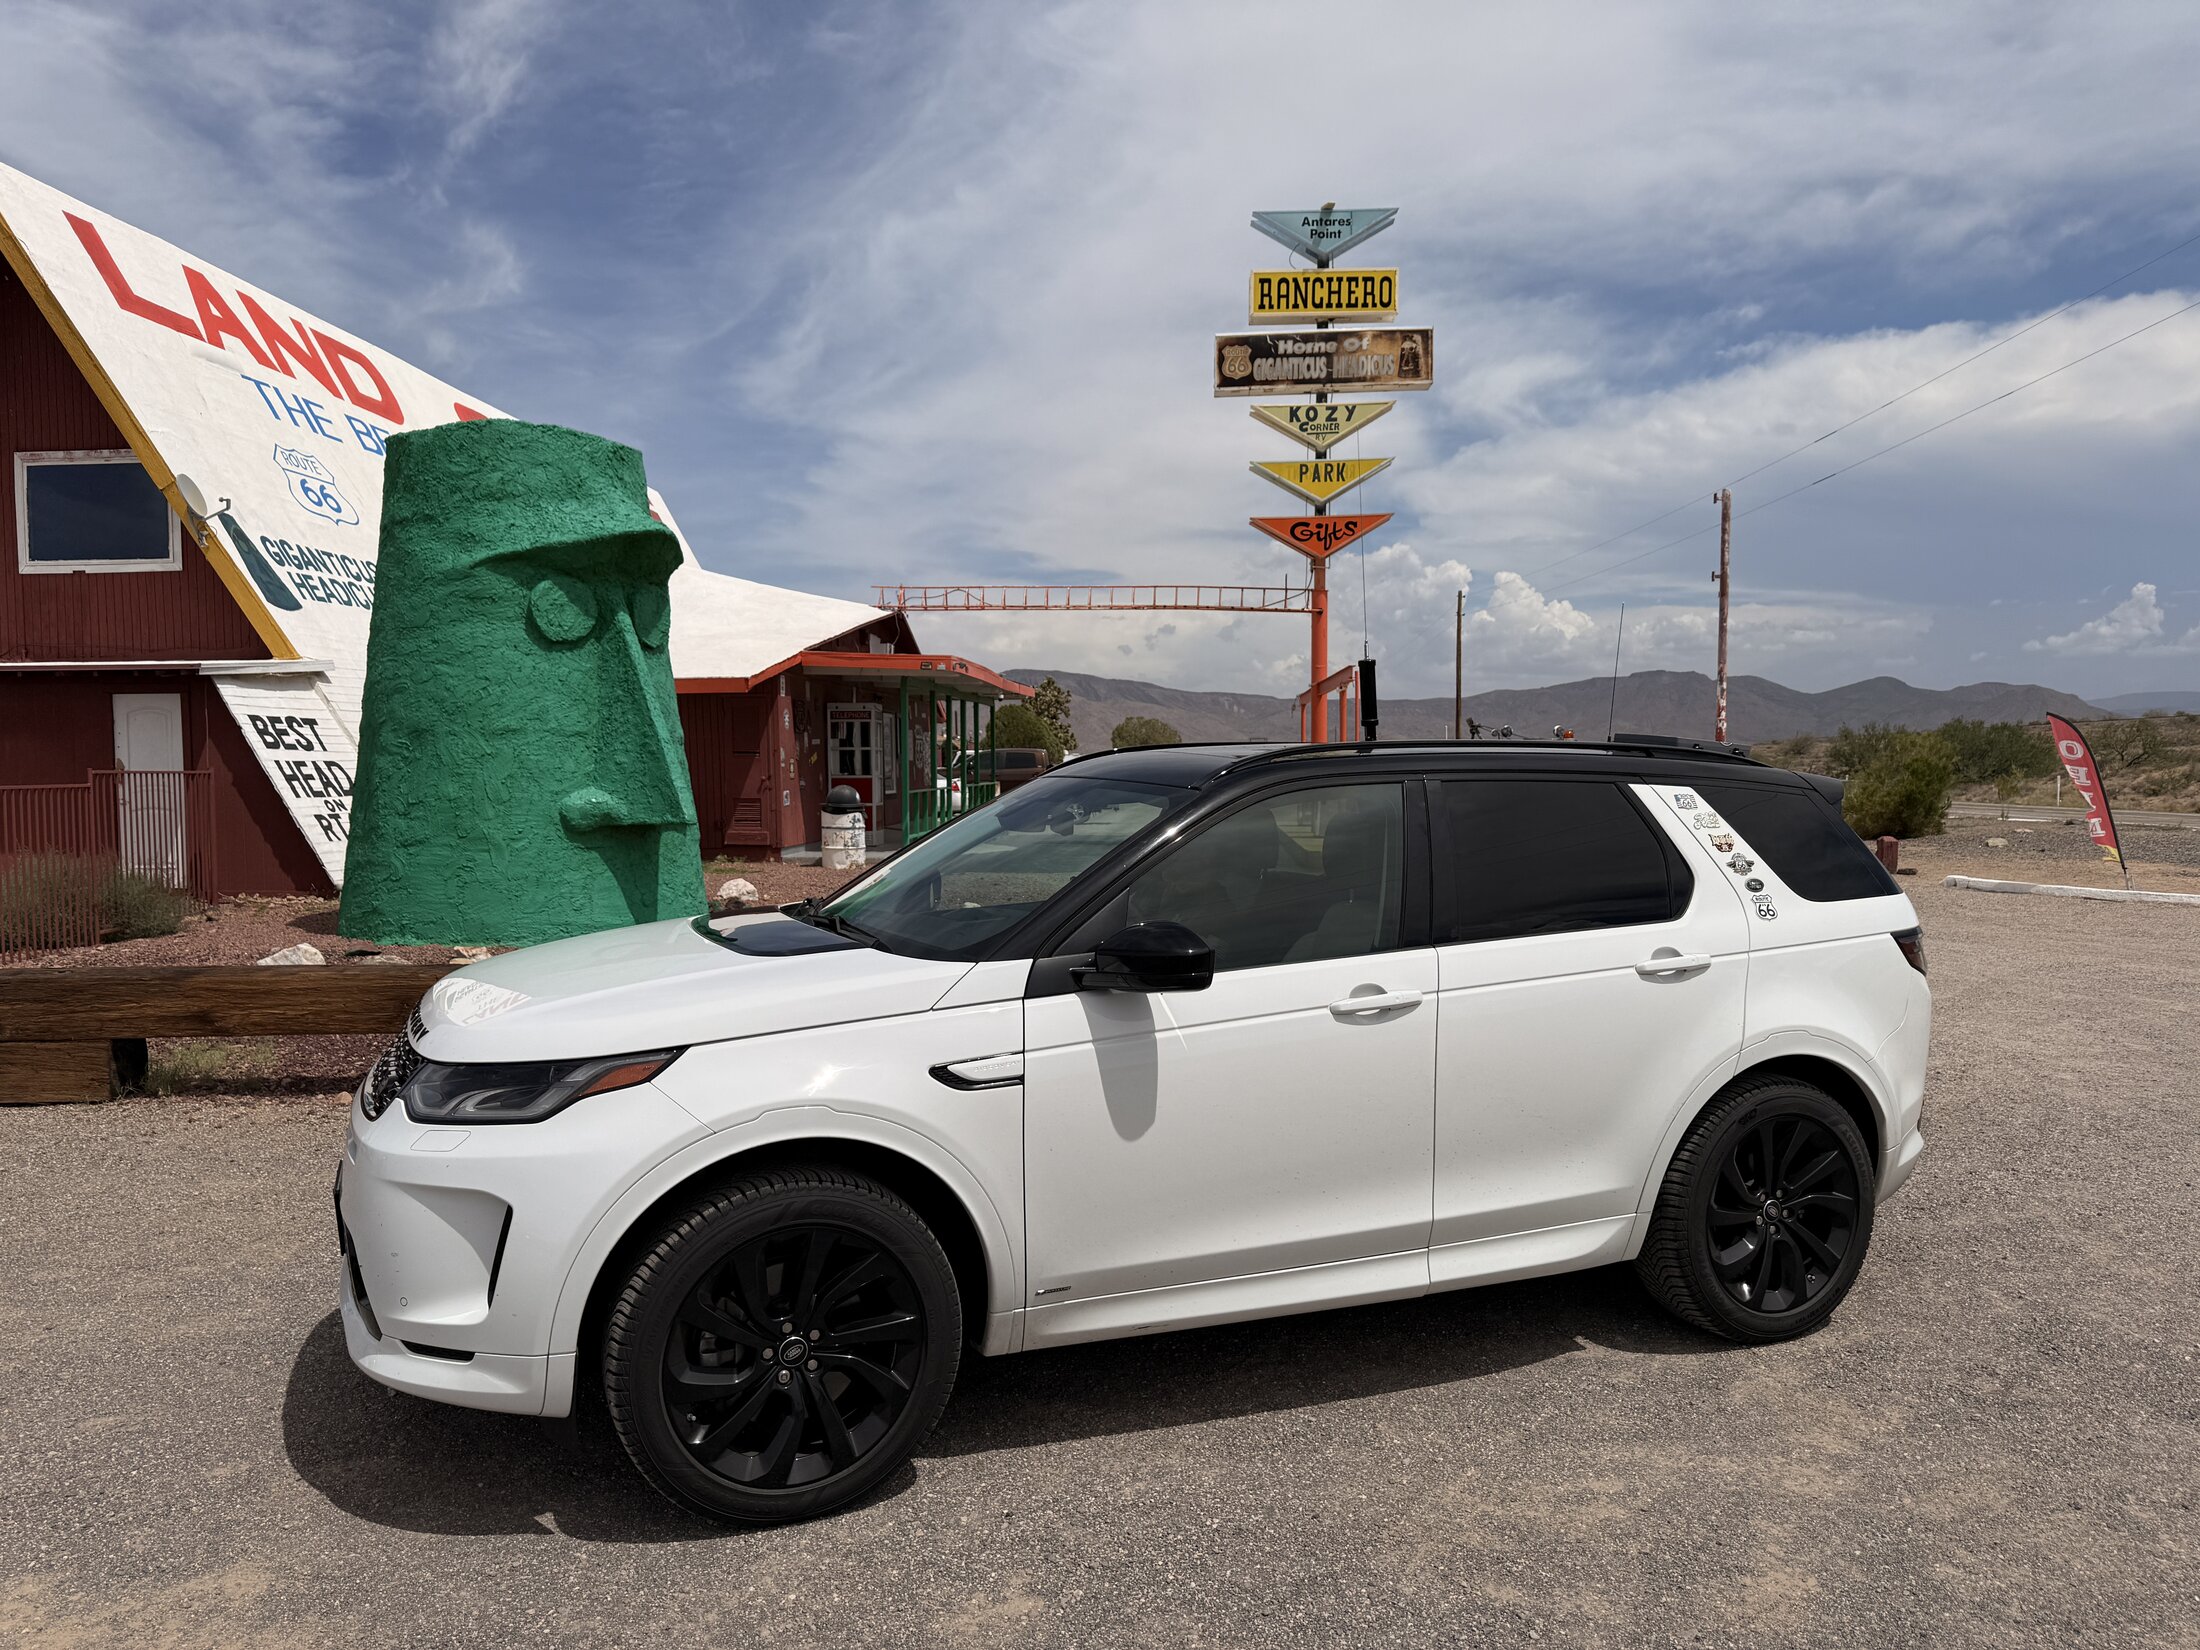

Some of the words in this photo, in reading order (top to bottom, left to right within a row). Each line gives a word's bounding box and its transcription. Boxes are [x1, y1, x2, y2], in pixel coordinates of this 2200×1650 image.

[1301, 217, 1351, 227] Antares
[1310, 229, 1342, 239] Point
[1258, 275, 1393, 310] RANCHERO
[62, 210, 405, 425] LAND
[1344, 337, 1369, 351] Of
[1227, 357, 1246, 373] 66
[1253, 357, 1327, 382] GIGANTICUS
[241, 374, 343, 443] THE
[1289, 405, 1357, 423] KOZY
[1299, 421, 1340, 433] CORNER
[1315, 433, 1327, 441] RV
[280, 450, 322, 476] ROUTE
[1299, 463, 1346, 482] PARK
[300, 479, 343, 514] 66
[1289, 521, 1358, 551] Gifts
[260, 535, 377, 584] GIGANTICUS
[832, 711, 870, 719] TELEPHONE
[247, 714, 328, 752] BEST
[274, 760, 355, 798] HEAD
[323, 799, 348, 813] ON
[314, 813, 349, 842] RT
[1758, 903, 1776, 917] 66
